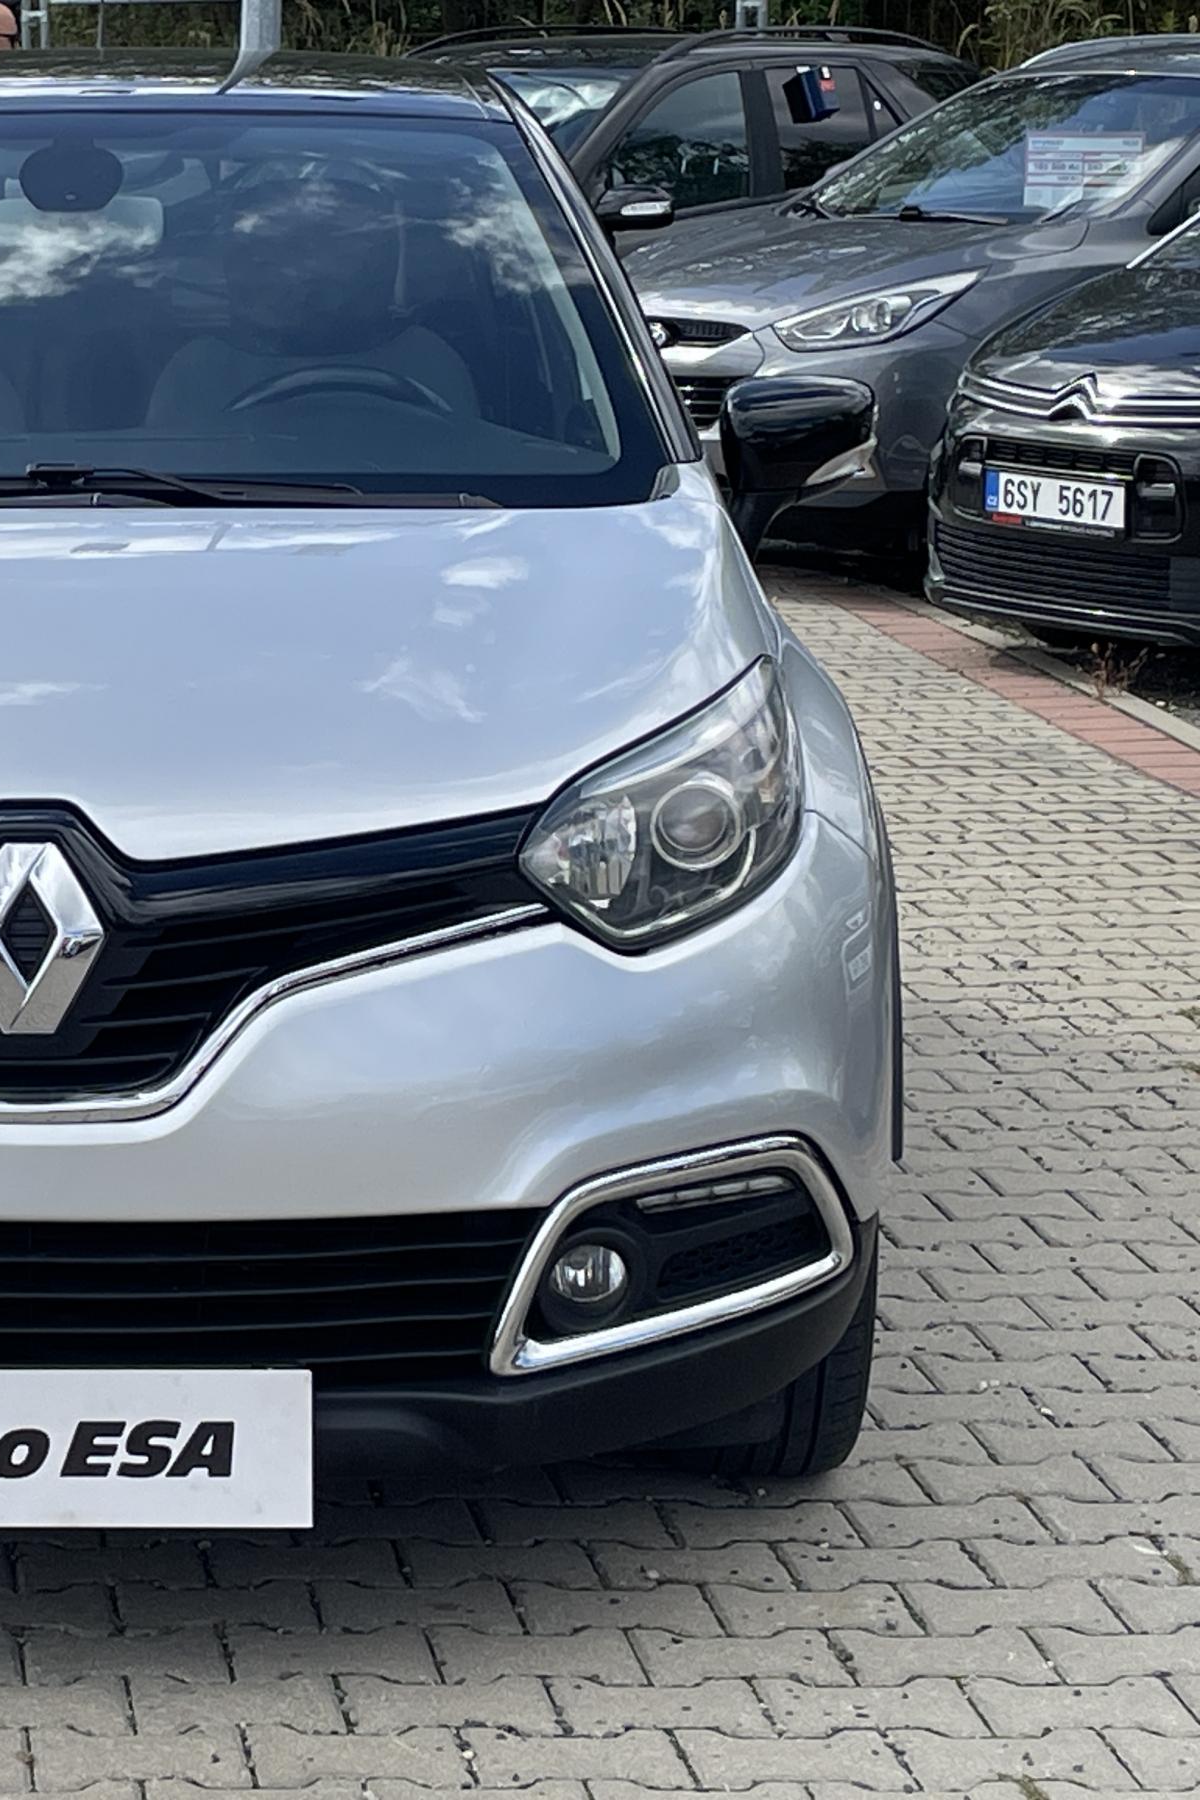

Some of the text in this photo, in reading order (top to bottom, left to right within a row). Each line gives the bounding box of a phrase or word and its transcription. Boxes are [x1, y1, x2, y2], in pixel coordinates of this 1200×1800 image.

[1003, 478, 1114, 521] 6SY 5617
[60, 1420, 235, 1478] ESA
